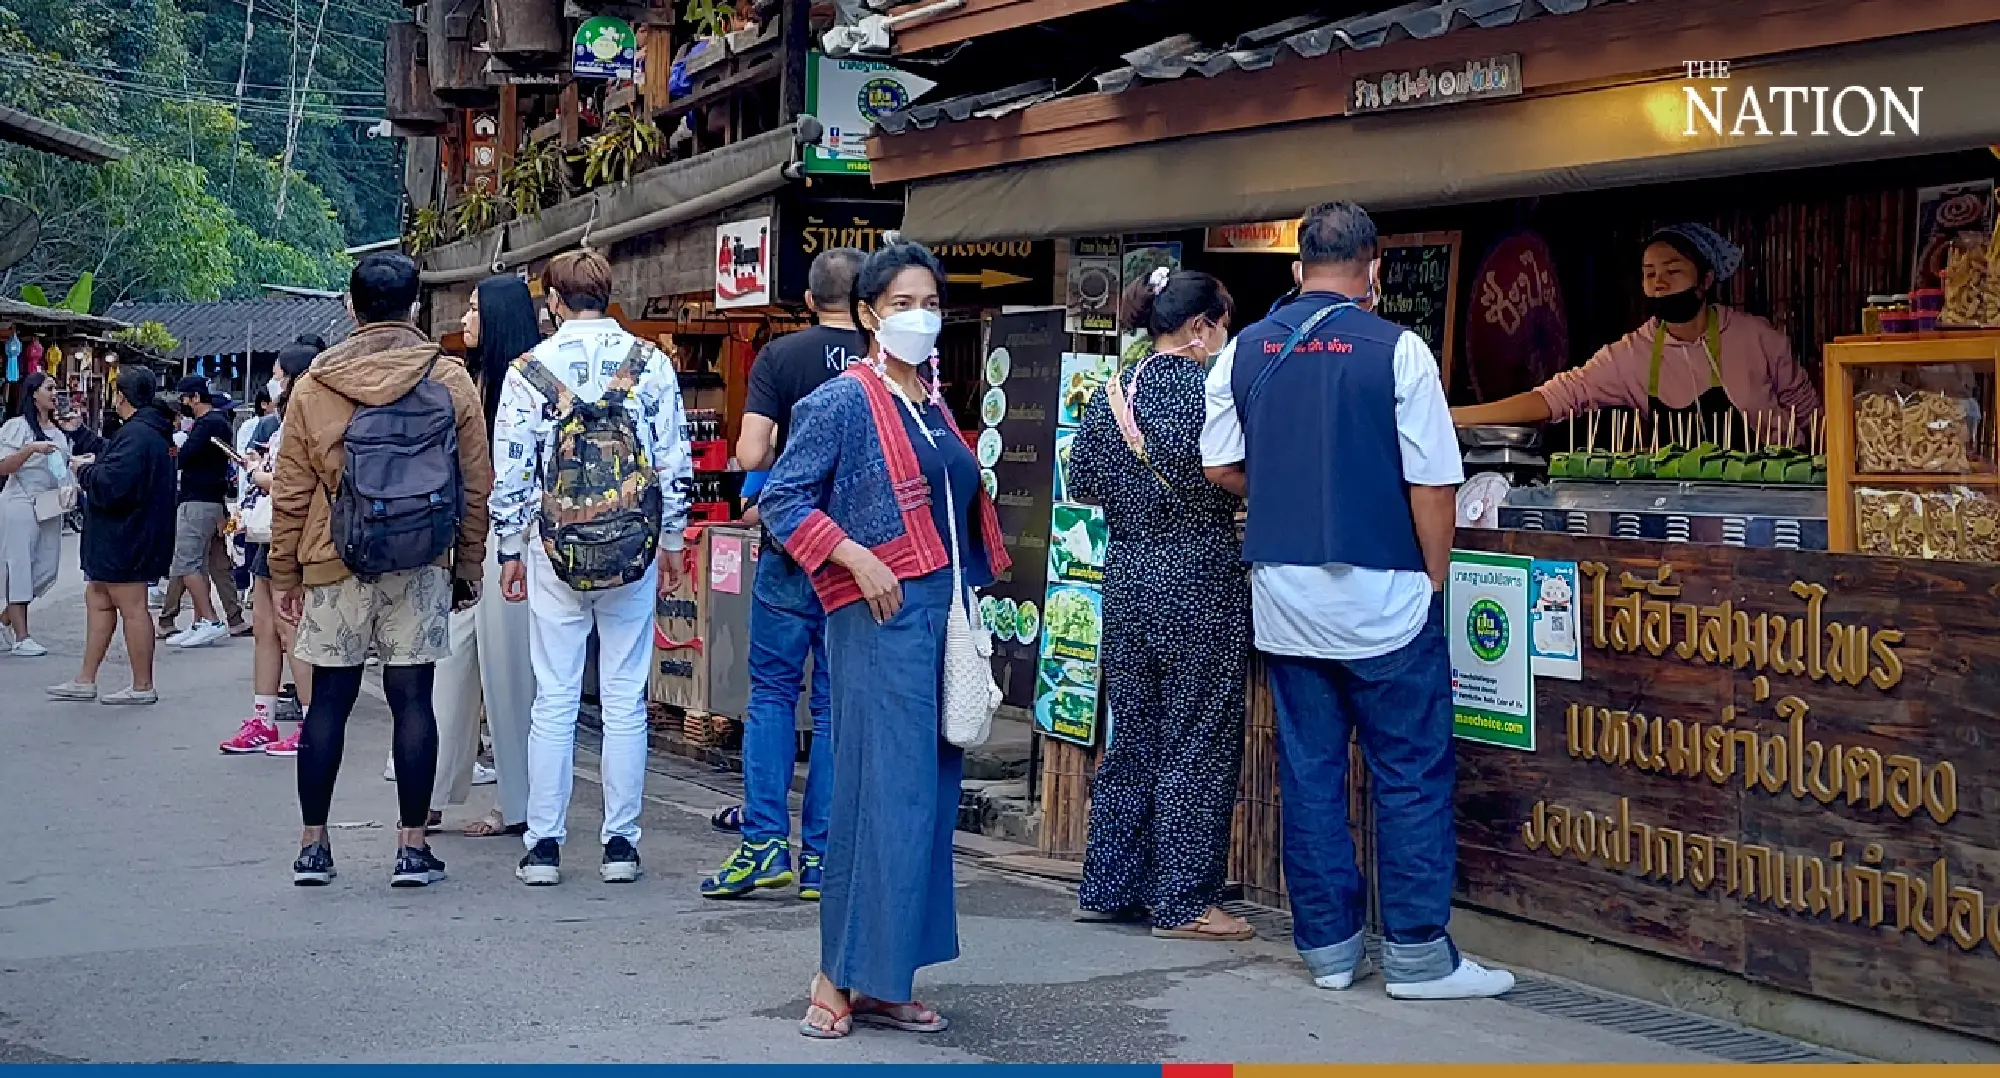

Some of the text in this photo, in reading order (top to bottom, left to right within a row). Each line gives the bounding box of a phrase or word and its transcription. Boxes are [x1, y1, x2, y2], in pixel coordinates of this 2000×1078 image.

[1580, 560, 1906, 702] ไส้อั่วสมุนไพร
[1565, 695, 1958, 824] แหนมย่างใบตอง
